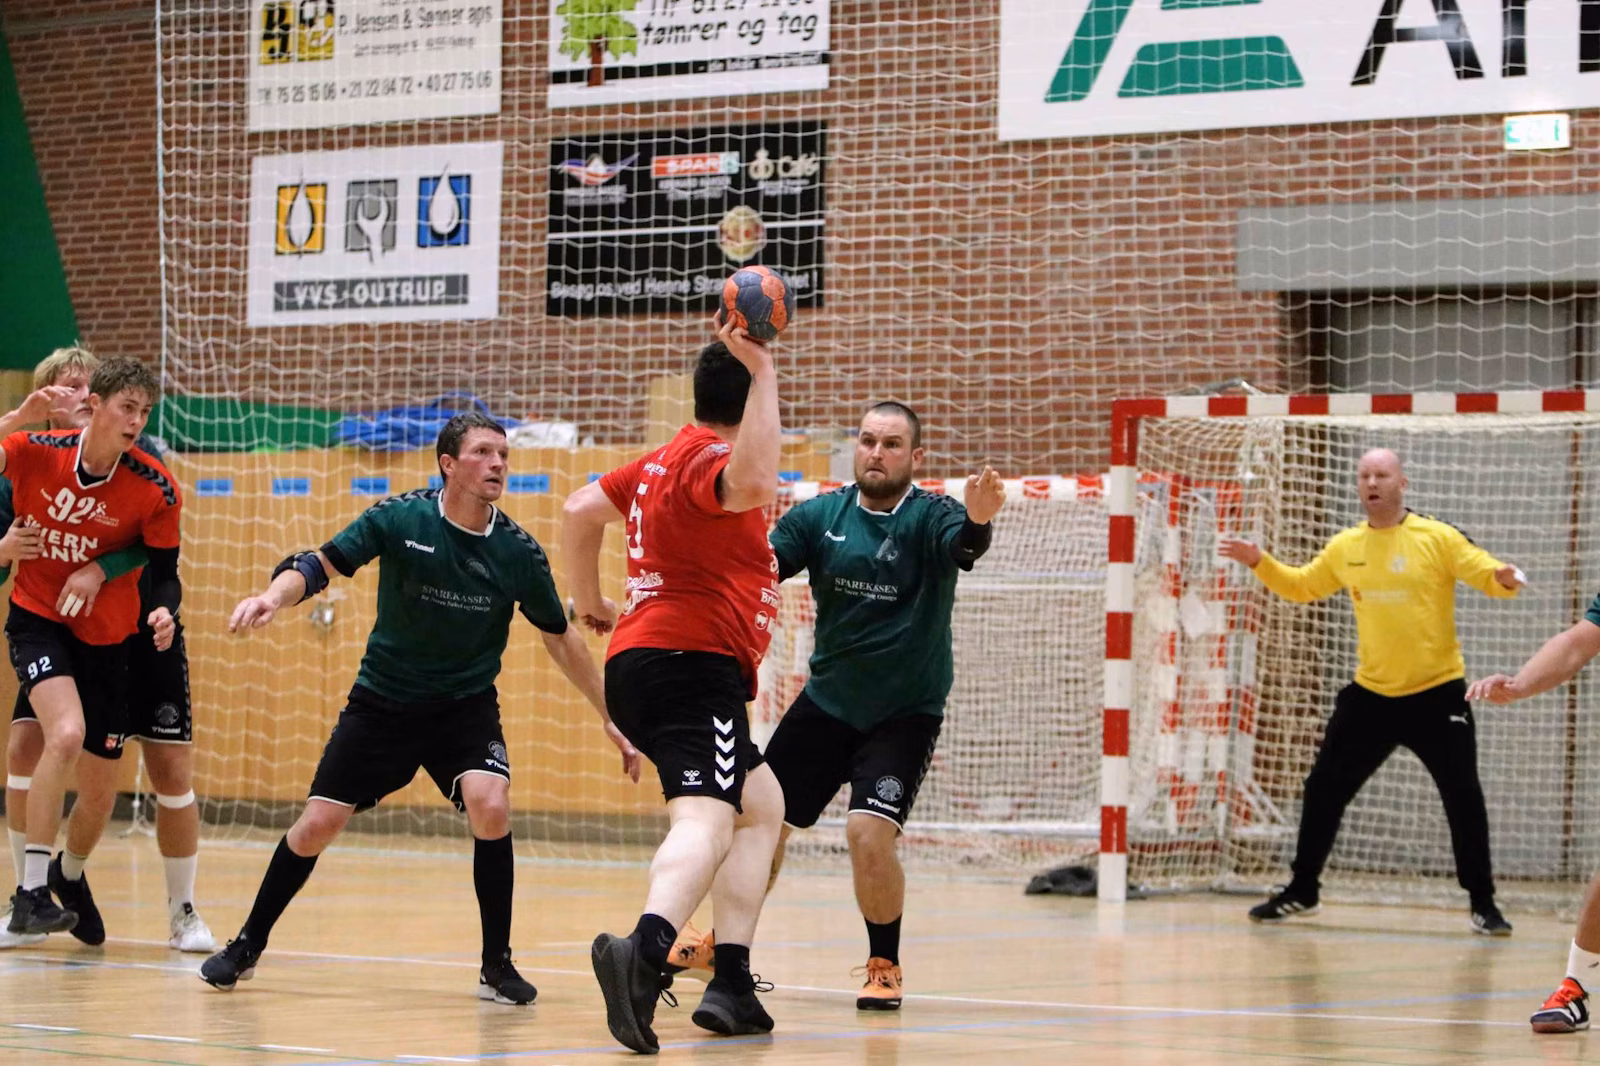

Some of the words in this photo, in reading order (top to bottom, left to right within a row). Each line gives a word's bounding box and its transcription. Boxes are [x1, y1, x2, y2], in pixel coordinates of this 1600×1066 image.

[643, 20, 728, 45] tømrer
[738, 18, 765, 45] og
[777, 11, 818, 41] tag
[365, 78, 380, 97] 22
[443, 72, 458, 91] 27
[665, 157, 720, 174] SPAR
[47, 486, 96, 524] 92
[37, 540, 90, 564] ANK
[421, 584, 493, 605] SPAREKASSEN
[27, 655, 53, 680] 92
[681, 779, 703, 787] hummel
[874, 800, 901, 814] hummel
